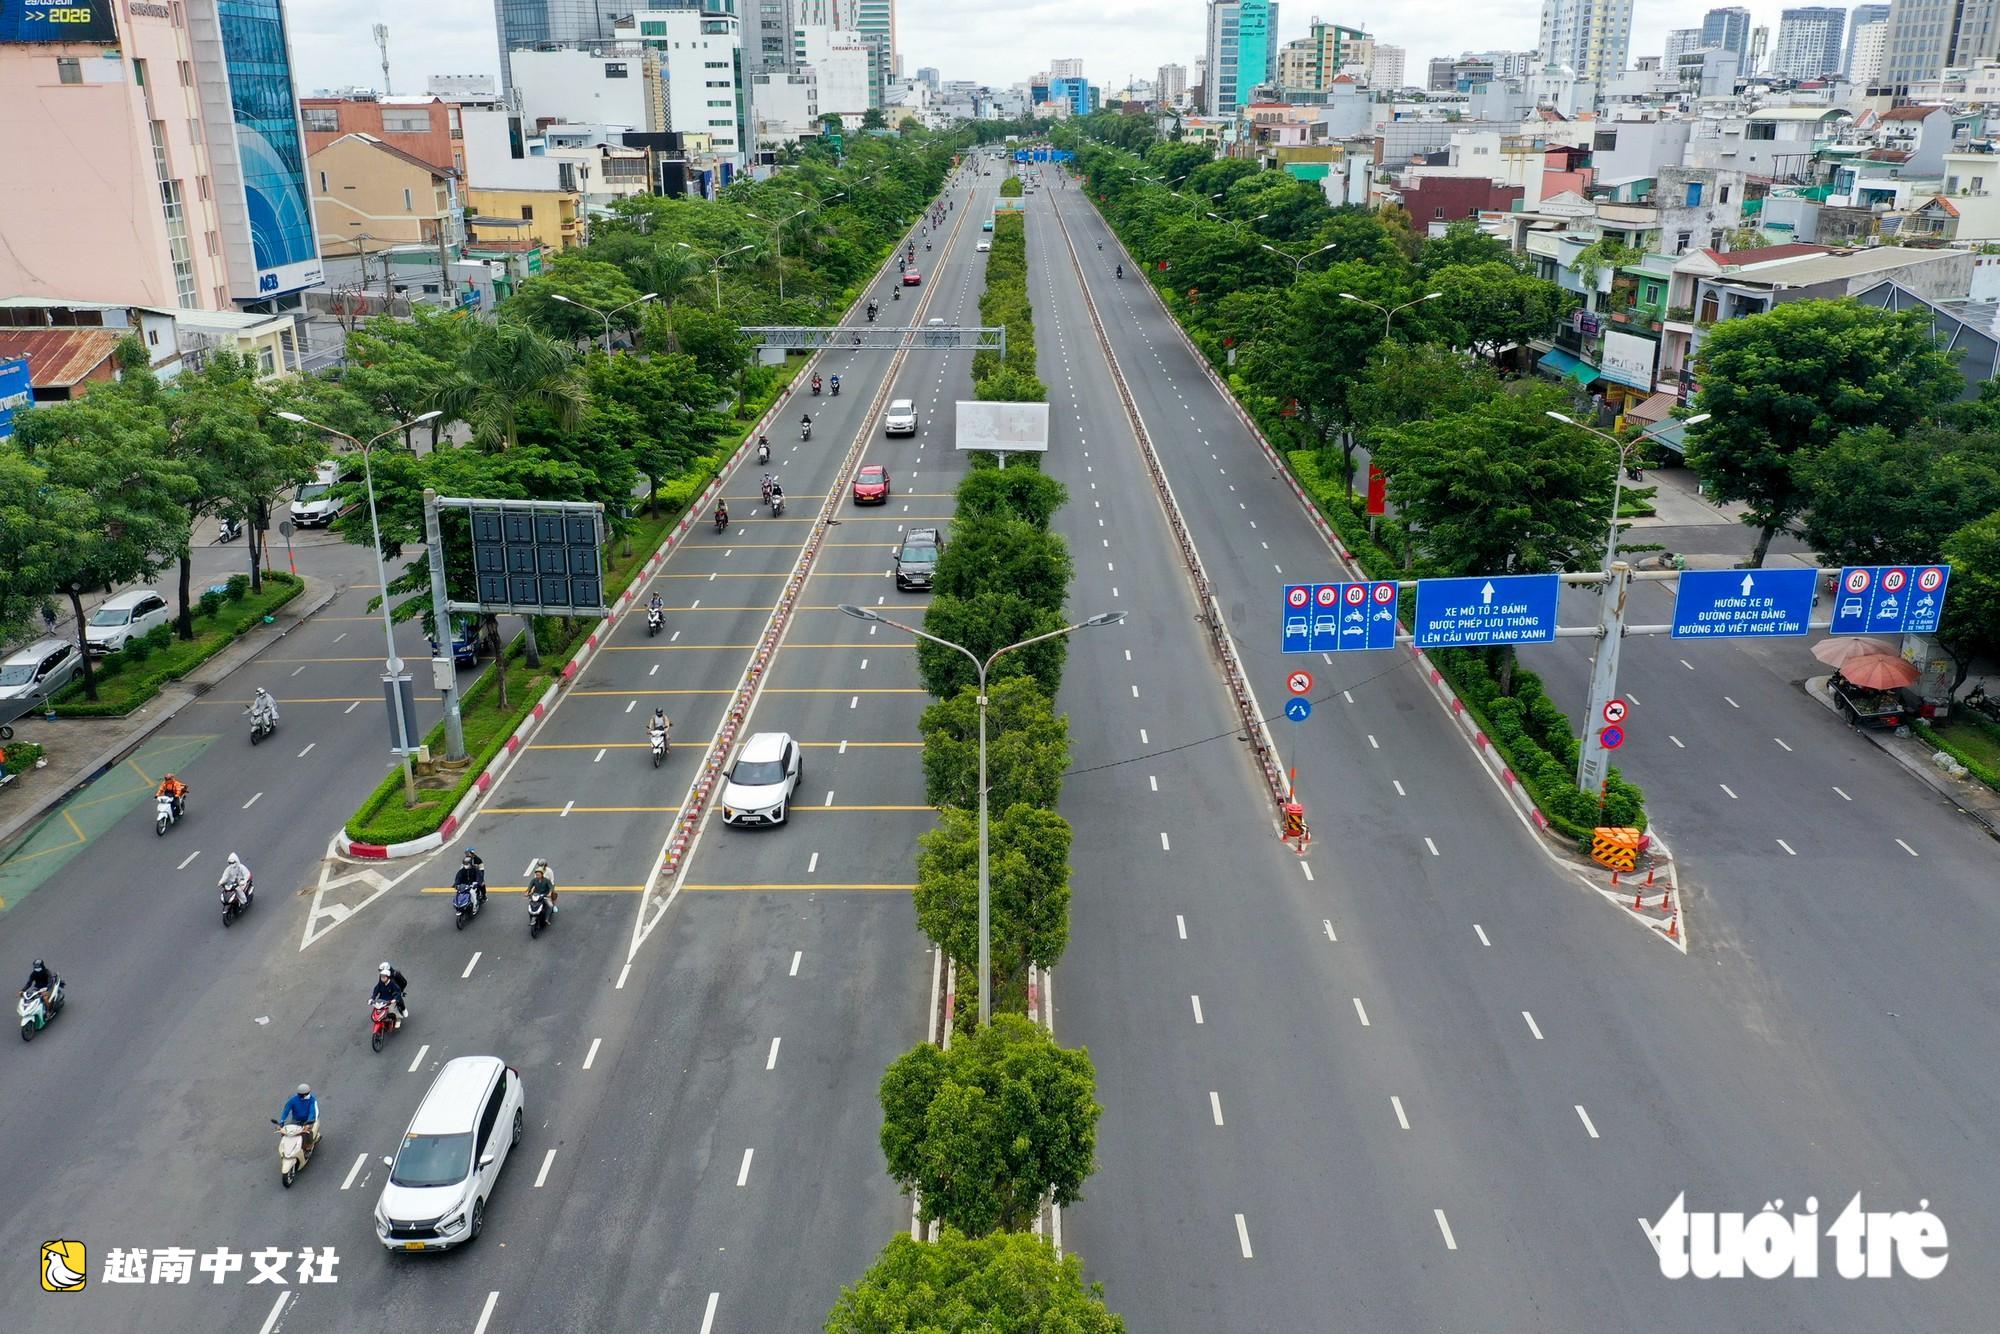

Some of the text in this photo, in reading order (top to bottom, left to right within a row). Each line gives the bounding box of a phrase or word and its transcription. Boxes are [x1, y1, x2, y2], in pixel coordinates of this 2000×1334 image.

[49, 8, 90, 22] 2026
[260, 274, 278, 292] ACB
[1852, 576, 1863, 588] 60
[1888, 574, 1900, 586] 60
[1924, 574, 1936, 586] 60
[1293, 593, 1302, 602] 60
[1322, 592, 1330, 600] 60
[1350, 590, 1360, 600] 60
[1378, 589, 1388, 599] 60
[1714, 597, 1773, 608] HƯỚNG XE ĐI
[1445, 603, 1527, 616] XE MÔ TÔ 2 BÁNH
[1699, 607, 1786, 621] ĐƯỜNG BẠCH ĐẰNG
[1430, 616, 1539, 630] ĐƯỢC PHÉP LƯU THÔNG
[1679, 620, 1799, 634] ĐƯỜNG XÔ VIẾT NGHỆ TĨNH
[1422, 629, 1546, 643] LÊN CẦU VƯỢT HÀNG XANH
